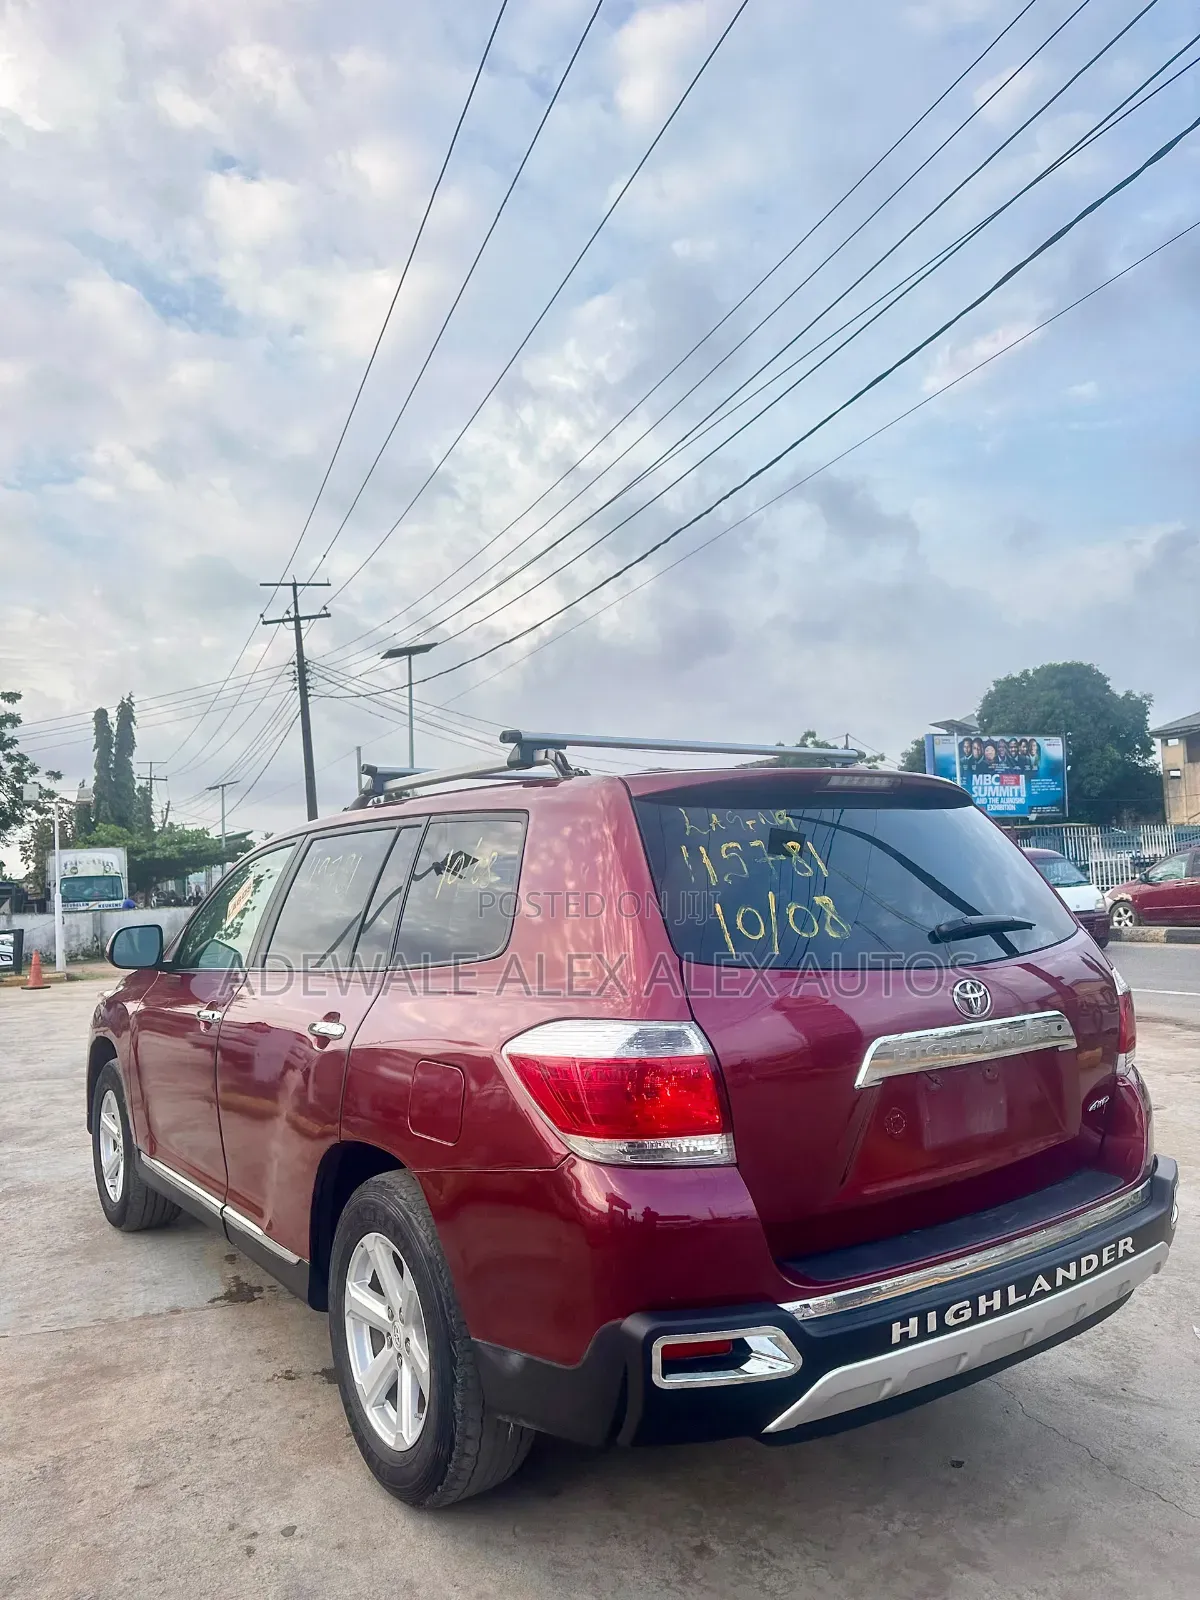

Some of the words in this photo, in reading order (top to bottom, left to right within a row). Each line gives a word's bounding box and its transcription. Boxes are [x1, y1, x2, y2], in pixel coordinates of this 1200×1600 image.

[972, 774, 1000, 786] MBC
[972, 786, 1020, 797] SUMMIT
[976, 797, 988, 805] AND
[714, 891, 852, 960] 10/08
[893, 1022, 1051, 1062] HIGHLANDER
[891, 1235, 1136, 1345] HIGHLANDER
